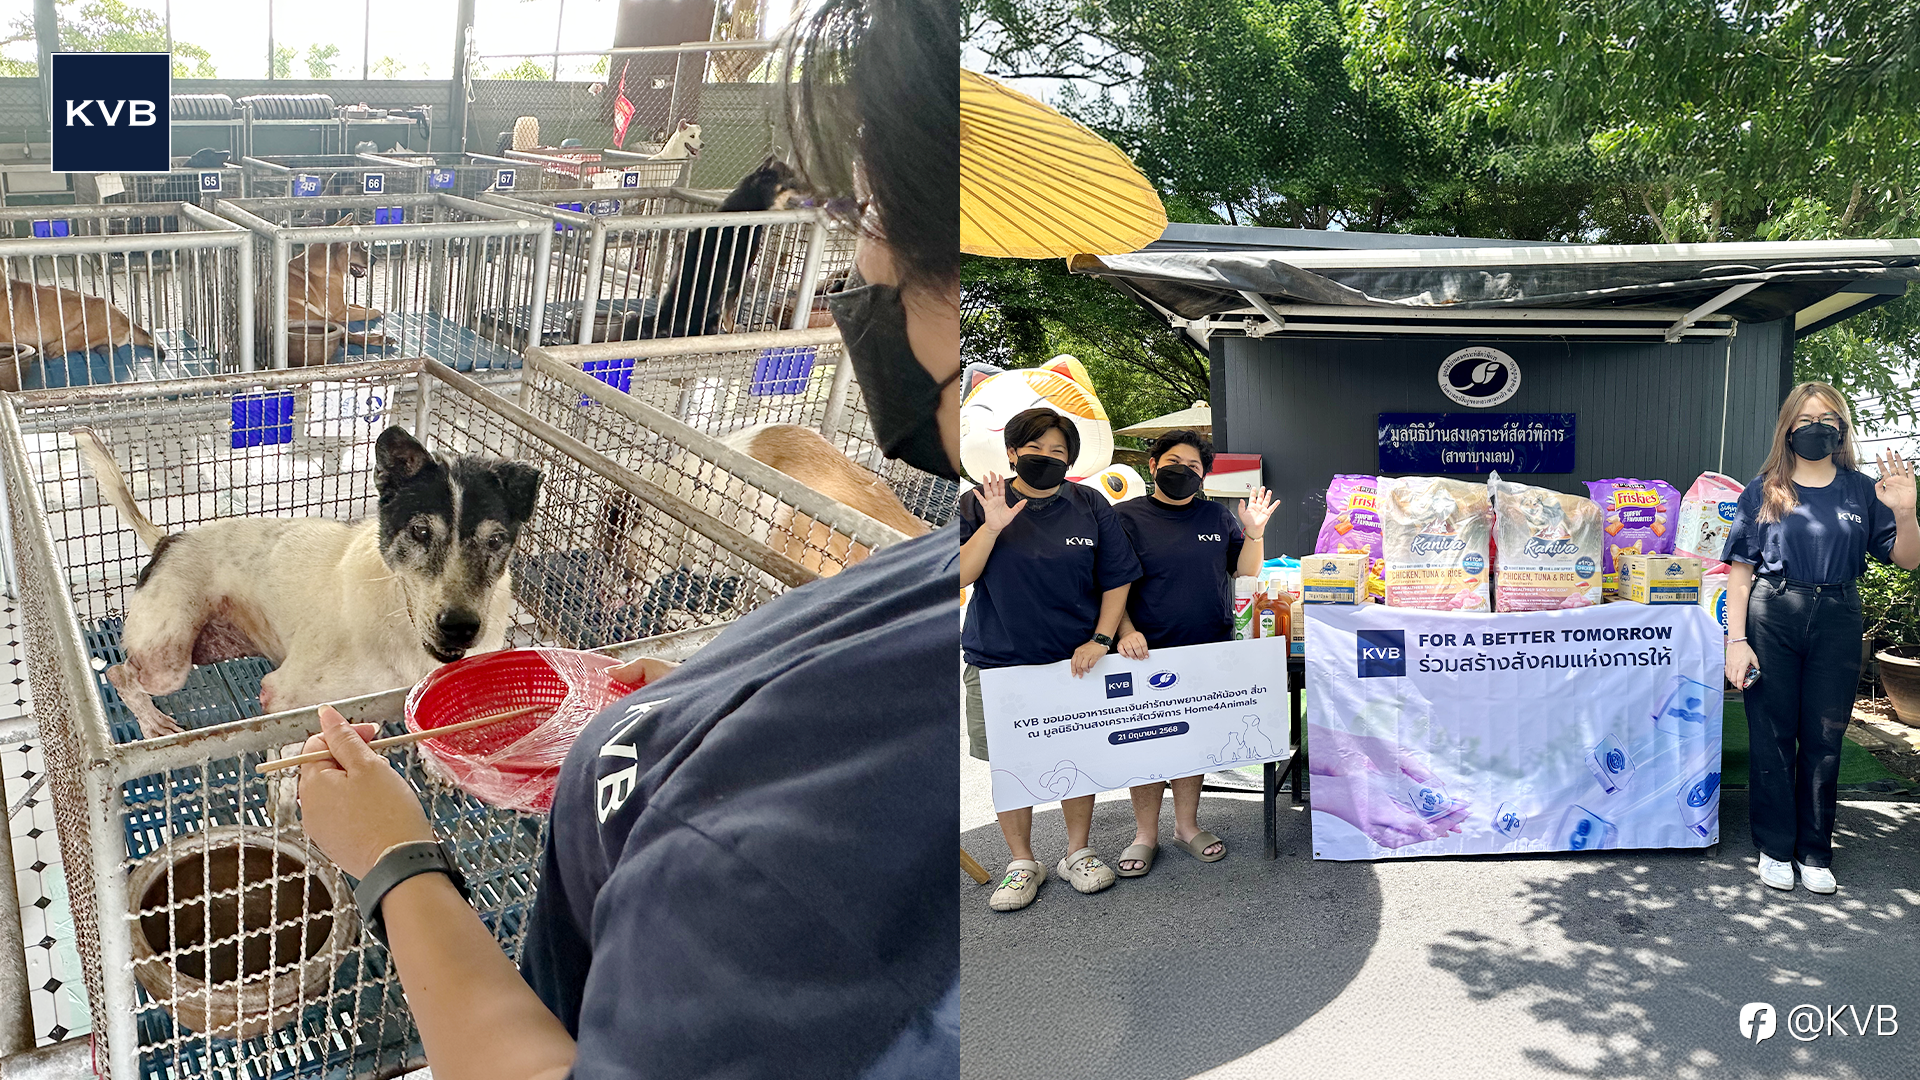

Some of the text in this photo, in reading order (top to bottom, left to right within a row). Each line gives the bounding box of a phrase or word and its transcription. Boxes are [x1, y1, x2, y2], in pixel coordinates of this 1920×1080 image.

[204, 176, 216, 186] 65
[368, 179, 379, 188] 66
[500, 174, 511, 183] 67
[626, 176, 636, 184] 68
[300, 182, 316, 191] 48
[1391, 422, 1564, 447] มูลนิธิบ้านสงเคราะห์สัตว์พิการ
[1442, 448, 1514, 464] (สาขาบางเลน)
[1352, 496, 1378, 508] Frisk
[1618, 492, 1657, 504] Friskies
[1838, 512, 1862, 524] KVB
[1066, 537, 1094, 546] KVB
[1198, 534, 1221, 542] KVB
[1411, 535, 1466, 556] Kaniva
[1524, 539, 1579, 558] Kaniva
[1392, 571, 1421, 579] CHICKEN,
[1419, 626, 1672, 647] FOR A BETTER TOMORROW
[1362, 647, 1400, 660] KVB
[1419, 647, 1672, 673] ร่วมสร้างสังคมแห่งการให้
[1108, 681, 1130, 690] KVB
[1014, 685, 1267, 729] KVB ขอมอบอาหารและเงินค่ารักษาพยาบาลให้น้องๆ สี่ขา
[1028, 730, 1039, 738] ณ
[1185, 698, 1257, 714] Home4Animals
[1128, 730, 1157, 739] มิถุนายน
[1159, 726, 1178, 734] 2568
